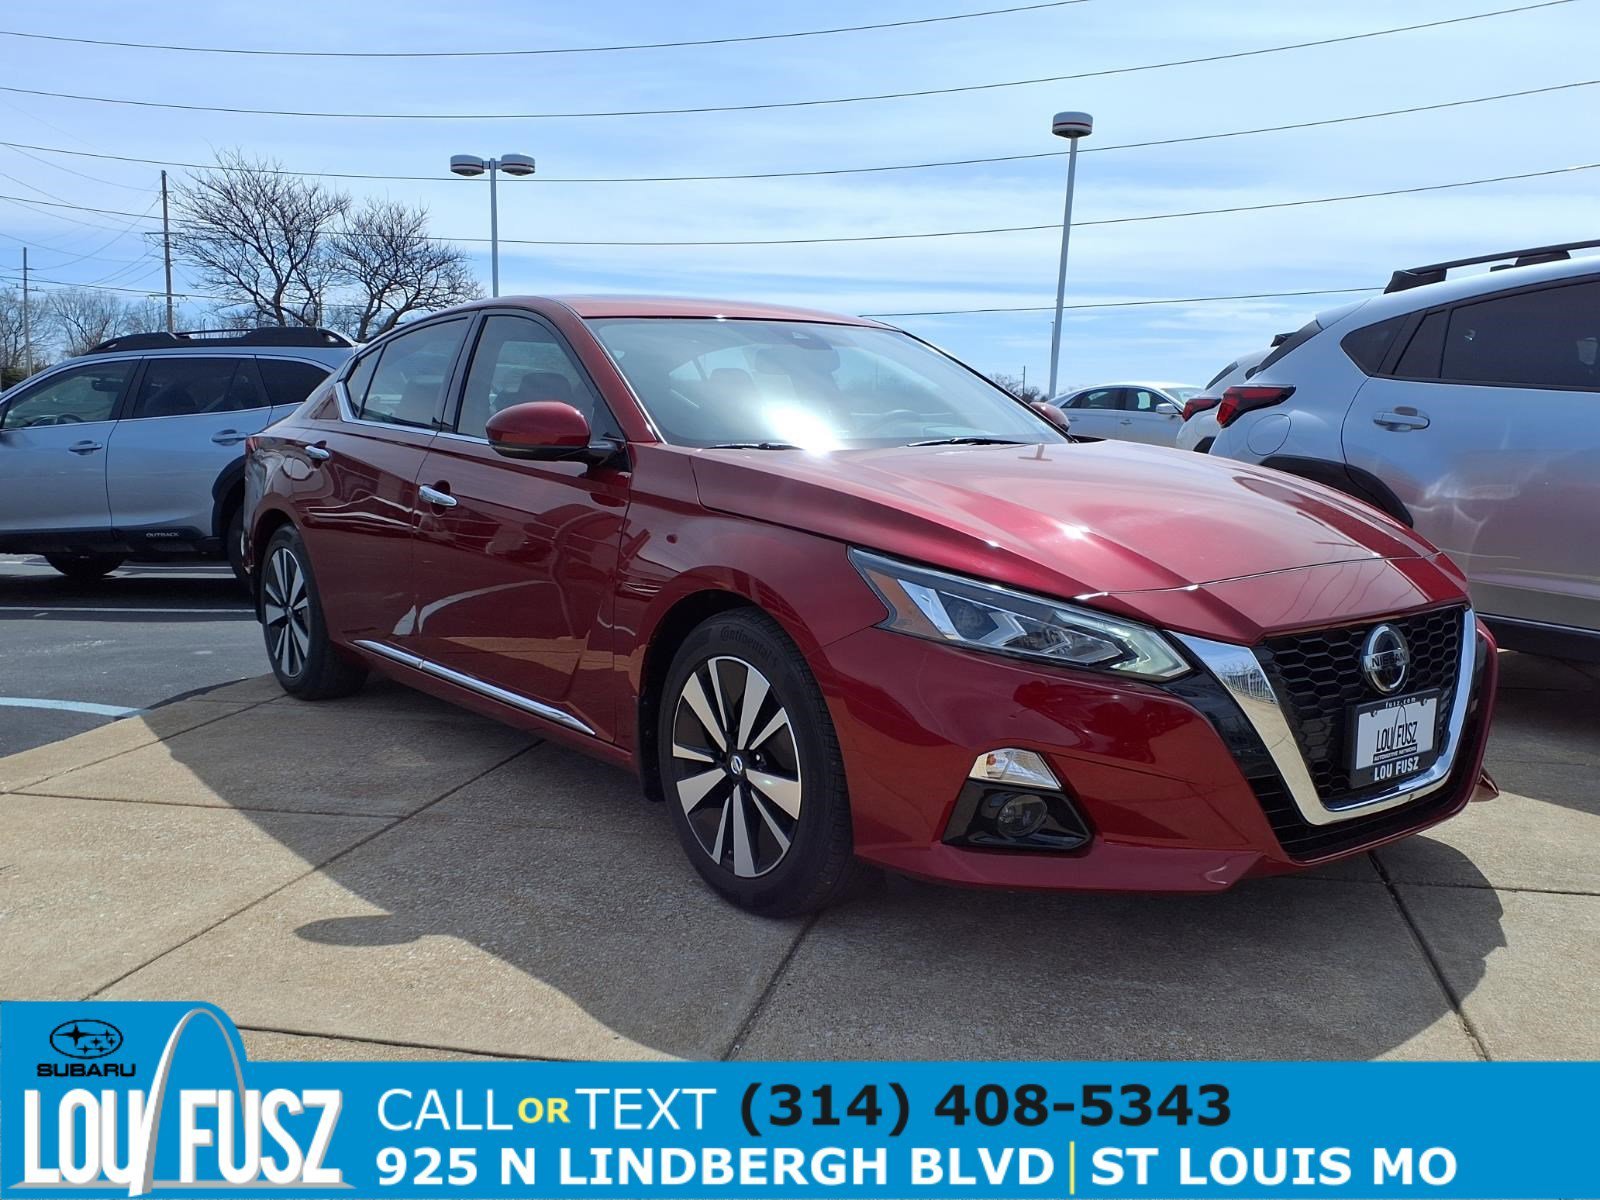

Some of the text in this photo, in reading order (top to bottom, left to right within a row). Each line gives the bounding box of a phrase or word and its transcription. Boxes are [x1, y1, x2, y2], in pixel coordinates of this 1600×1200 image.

[1372, 653, 1406, 668] NISSAN
[1376, 722, 1418, 752] LOU FUSZ
[1374, 756, 1419, 781] LOU FUSZ
